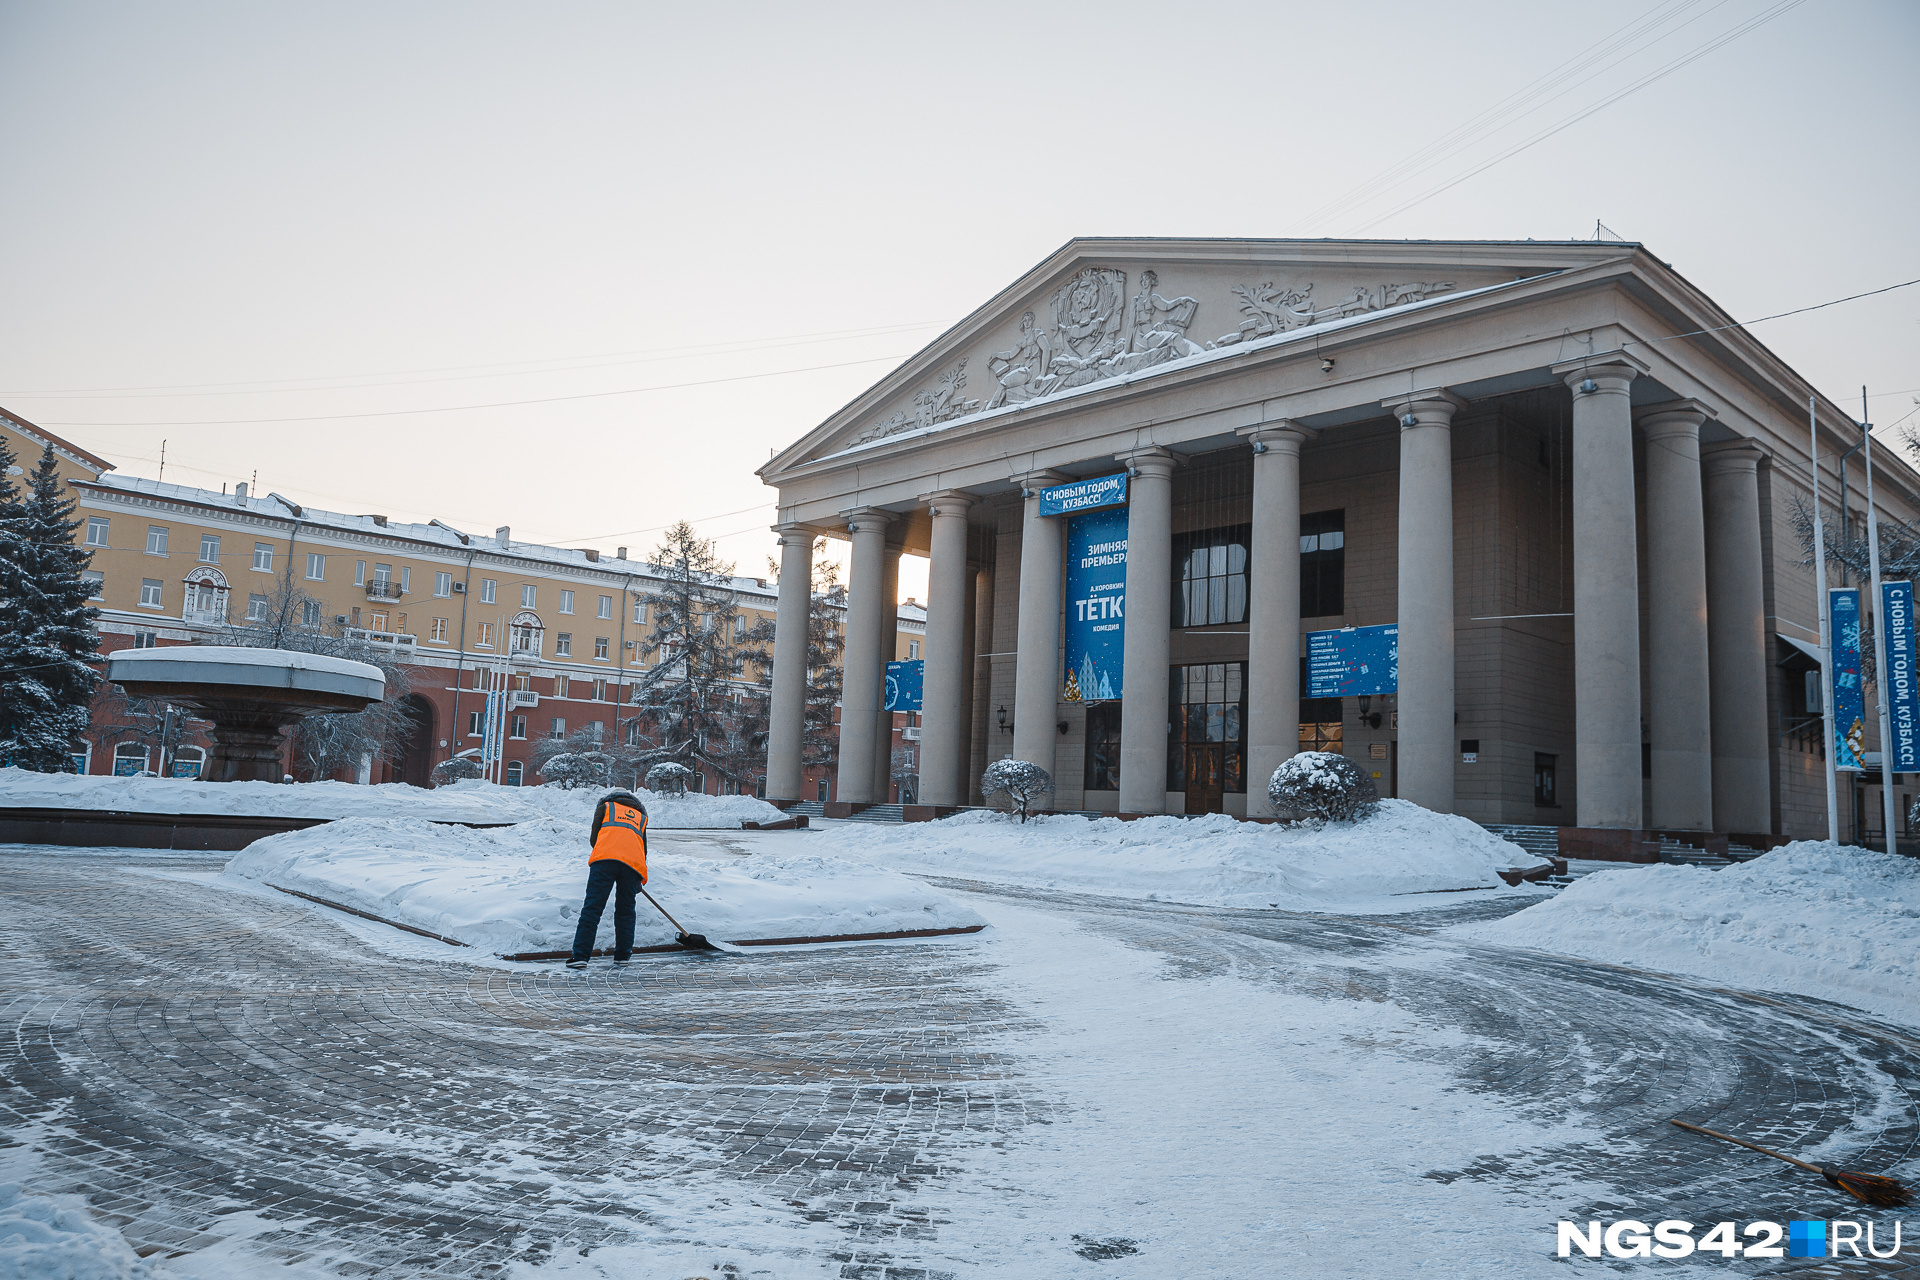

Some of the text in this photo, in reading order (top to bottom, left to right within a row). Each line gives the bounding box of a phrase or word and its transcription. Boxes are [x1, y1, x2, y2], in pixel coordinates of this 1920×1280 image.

[1045, 478, 1120, 501] С НОВЫМ ГОДОМ,
[1062, 493, 1102, 510] КУЗБАСС!
[1087, 540, 1128, 556] ЗИМНЯЯ
[1090, 582, 1124, 593] А.КОРОВКИН
[1092, 623, 1120, 632] КОМЕДИЯ
[1890, 589, 1915, 766] С НОВЫМ ГОДОМ, КУЗБАСС!
